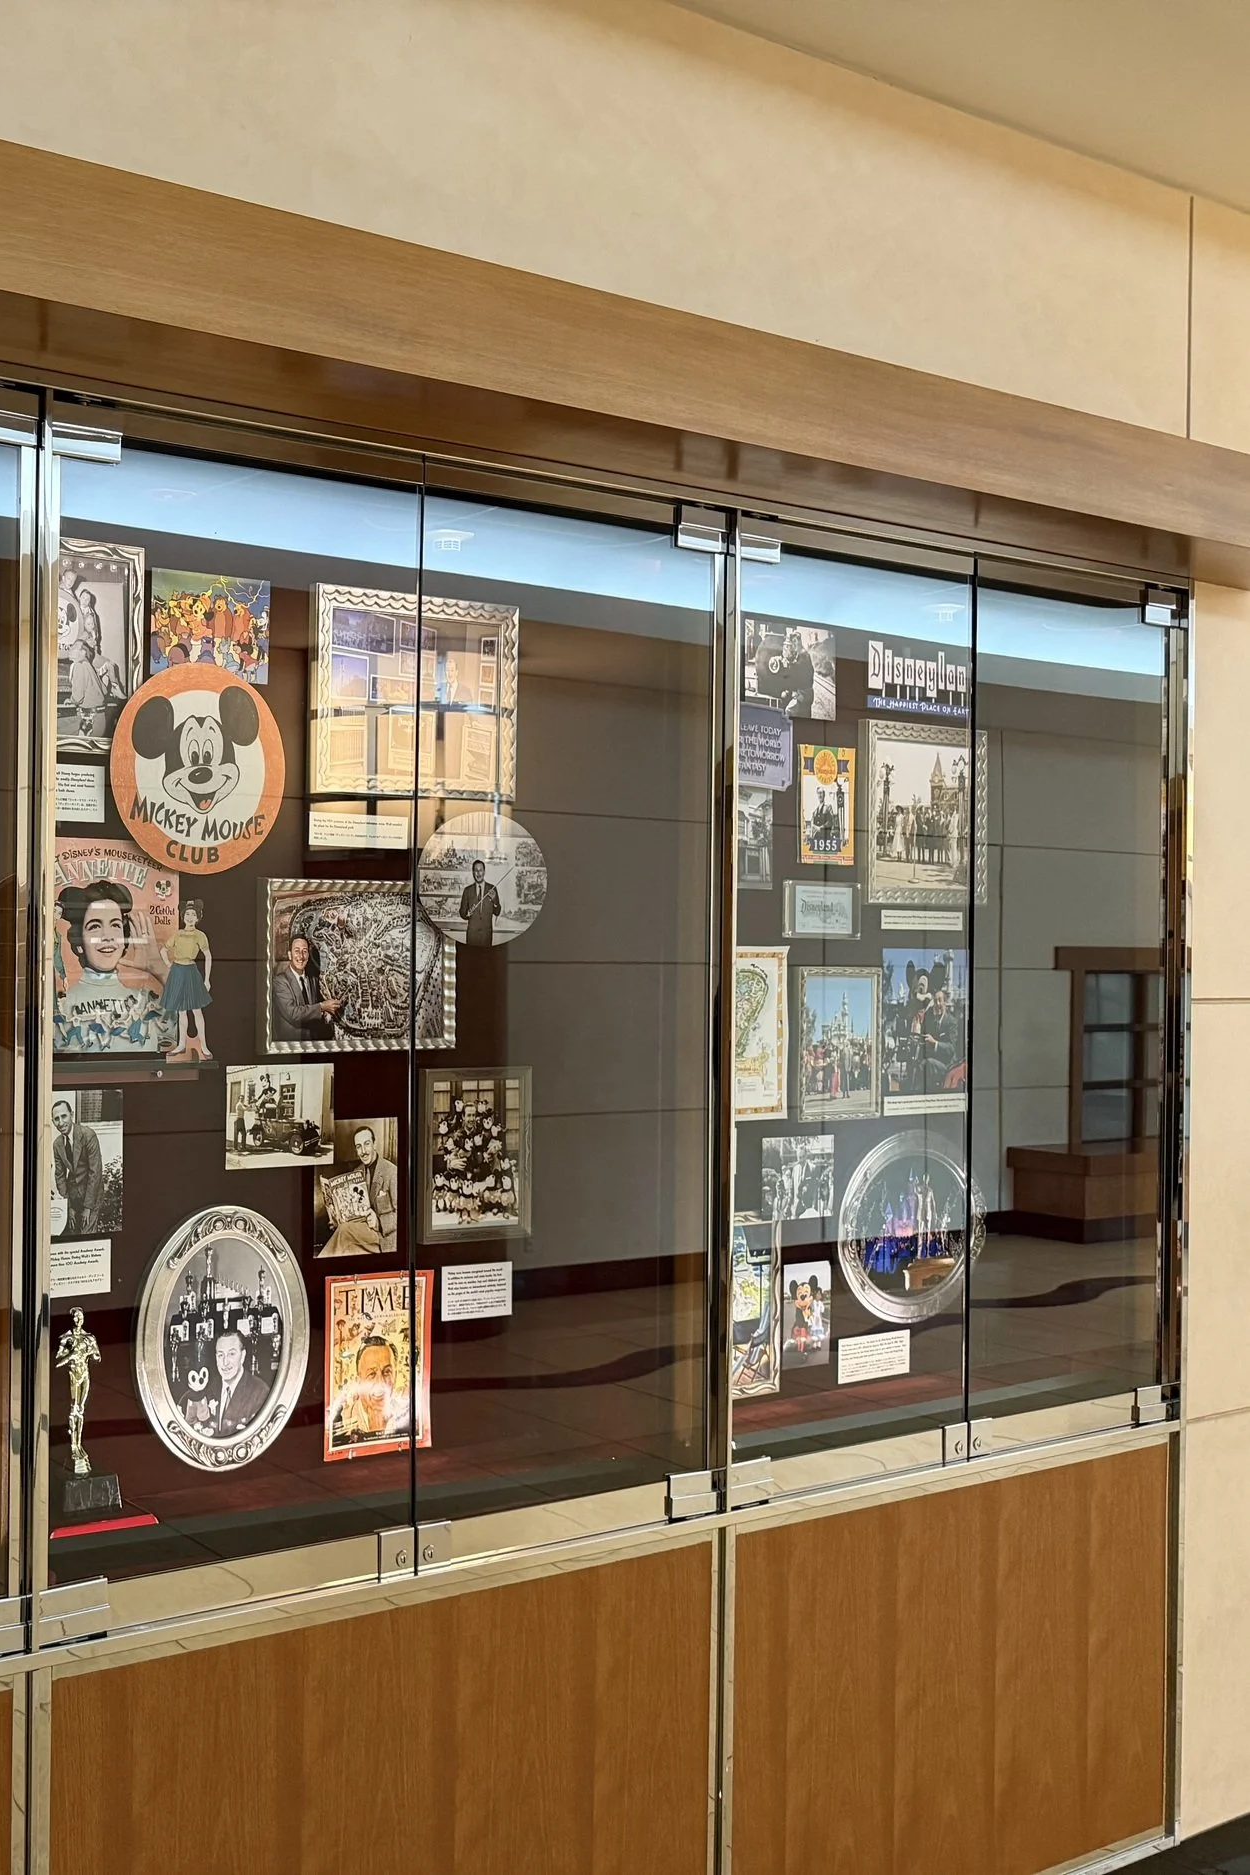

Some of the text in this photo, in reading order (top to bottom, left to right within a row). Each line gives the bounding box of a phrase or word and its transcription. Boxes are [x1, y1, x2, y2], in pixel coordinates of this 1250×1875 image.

[868, 642, 966, 694] Disneylan
[872, 697, 969, 716] THE HAPPIEST PLACE ON EART
[758, 737, 782, 748] WORLD
[760, 726, 782, 736] TODAY
[130, 792, 266, 842] MICKEY MOUSE
[166, 840, 220, 864] CLUB
[814, 839, 837, 851] 1955
[62, 846, 162, 872] DISNEY'S MOUSEKETEER
[54, 857, 148, 890] ANNETTE
[154, 916, 170, 925] Dolls
[338, 1286, 414, 1316] TIME
